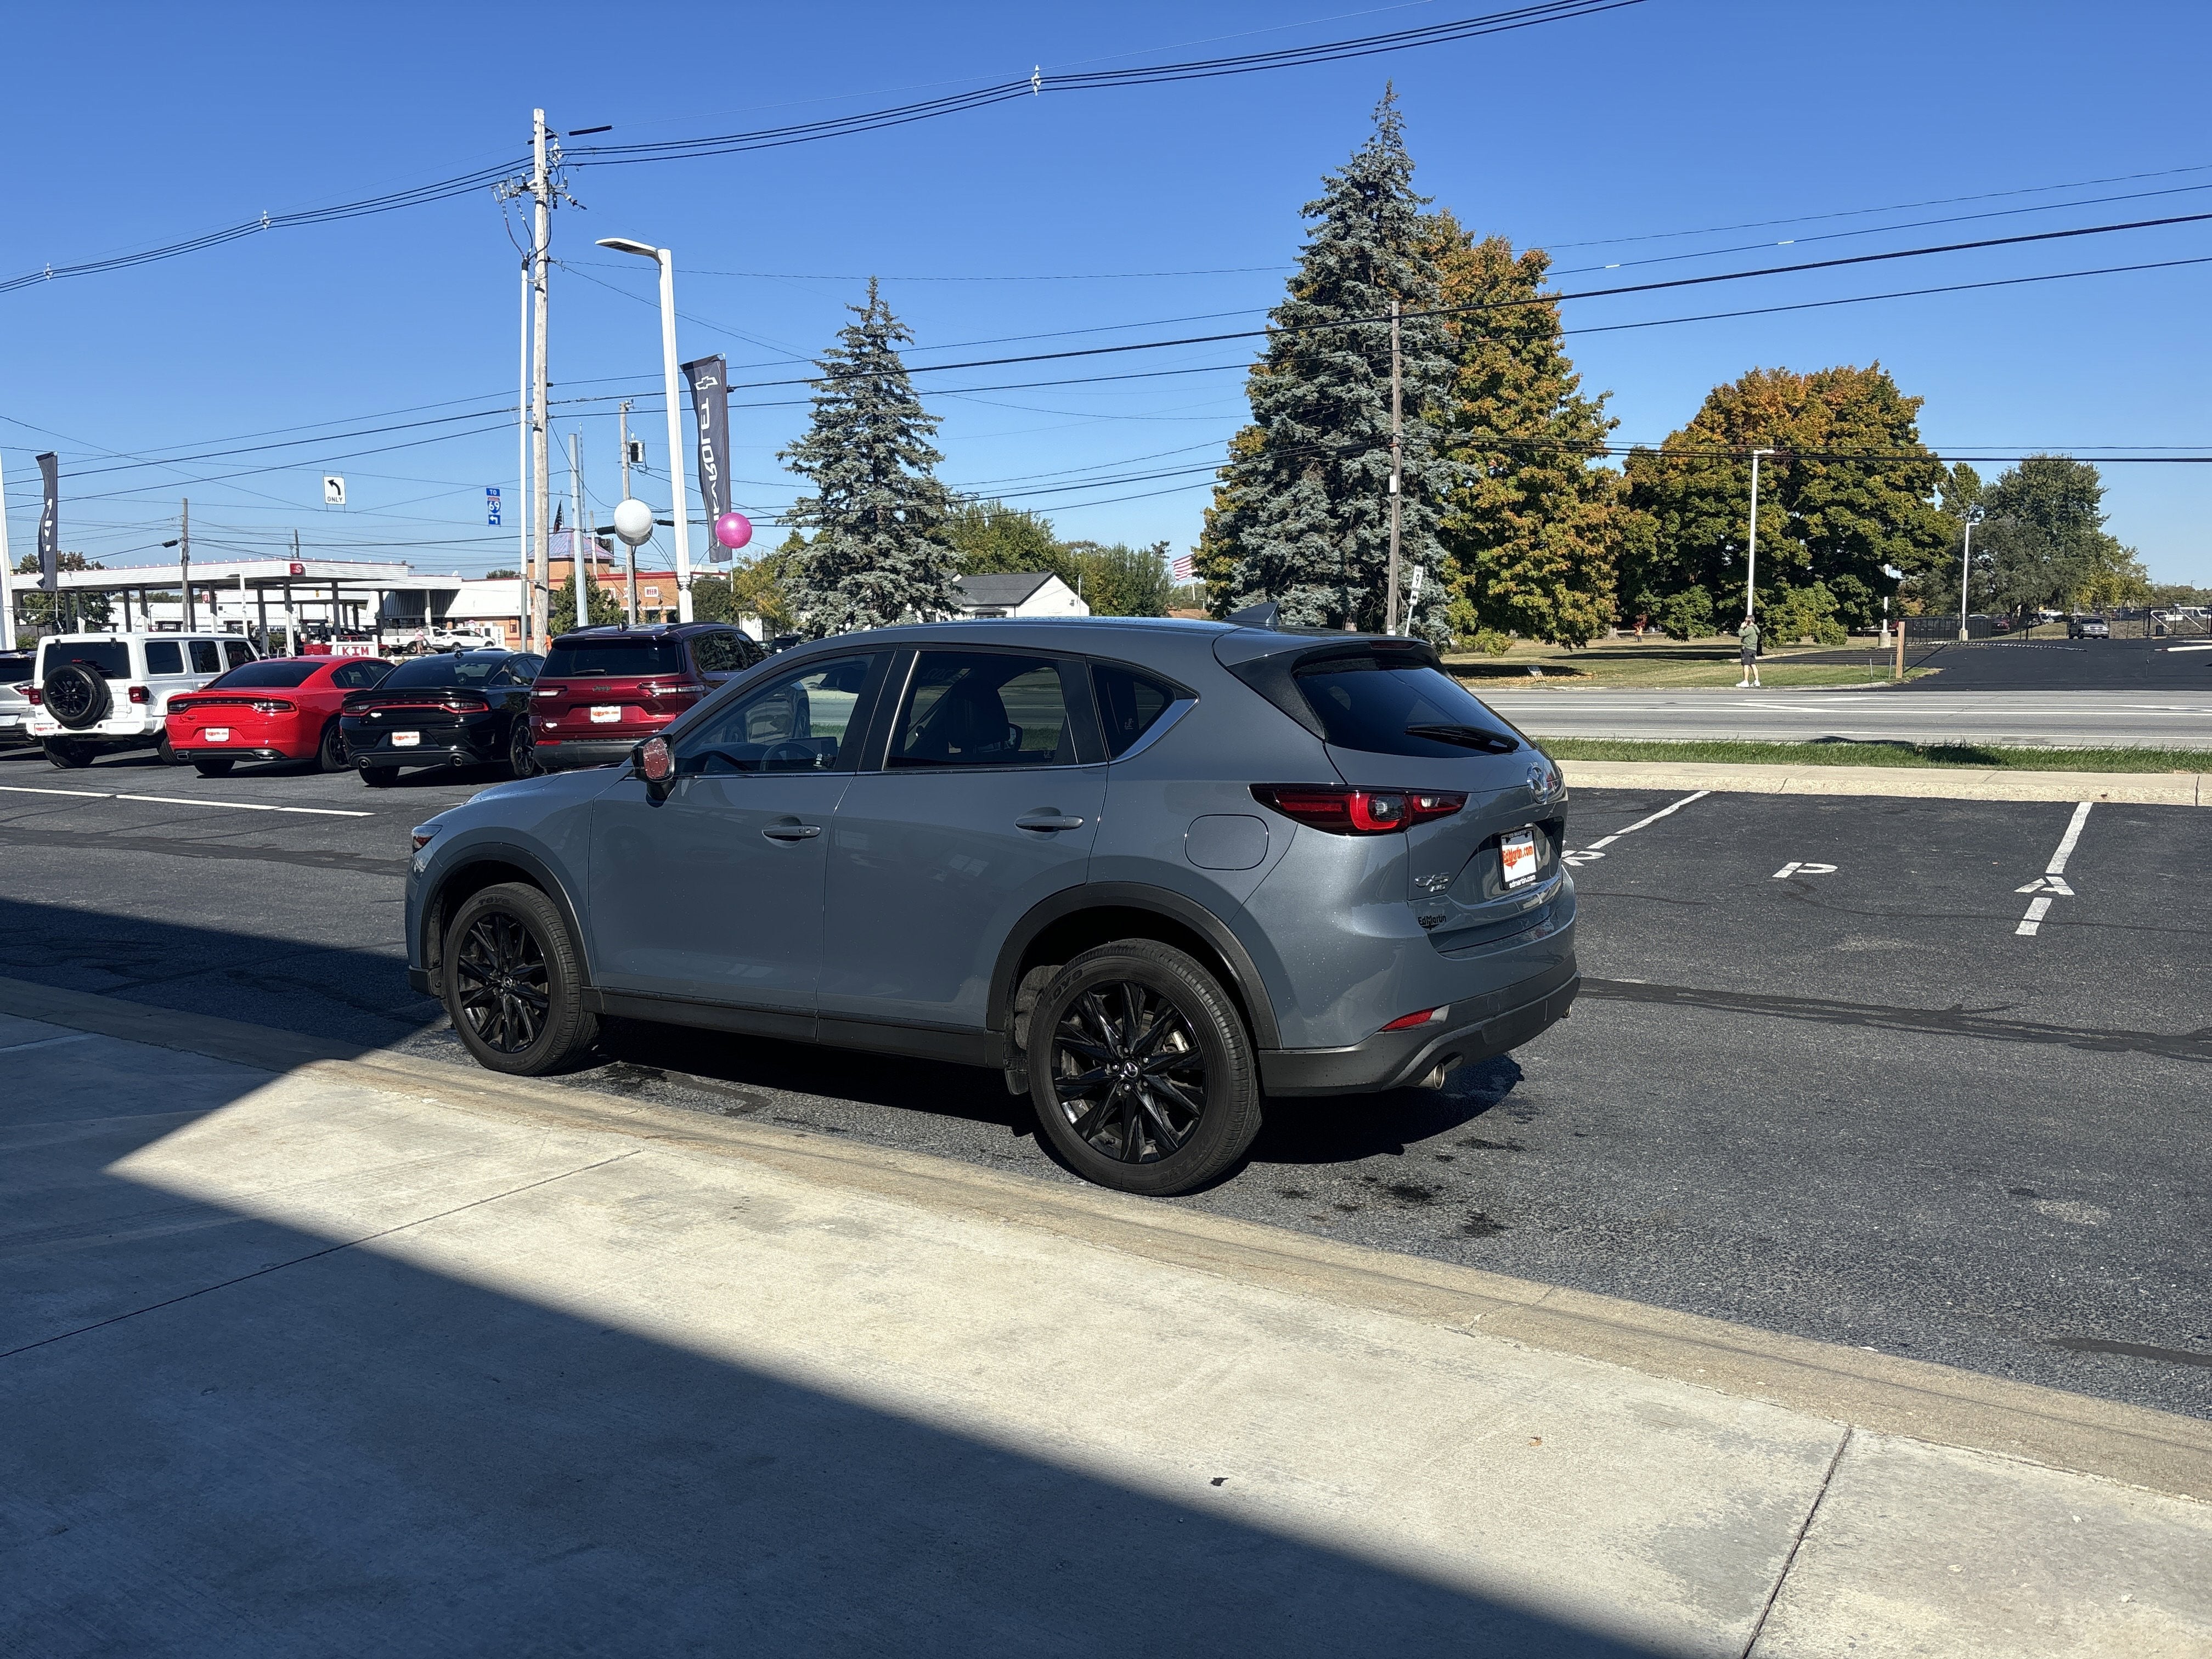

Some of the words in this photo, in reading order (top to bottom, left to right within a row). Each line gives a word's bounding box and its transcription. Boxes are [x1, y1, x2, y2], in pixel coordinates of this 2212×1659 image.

[489, 501, 500, 511] 69
[1415, 574, 1420, 586] 9
[342, 646, 369, 656] KIM
[1415, 872, 1449, 888] CX-5
[478, 896, 510, 905] TOYO
